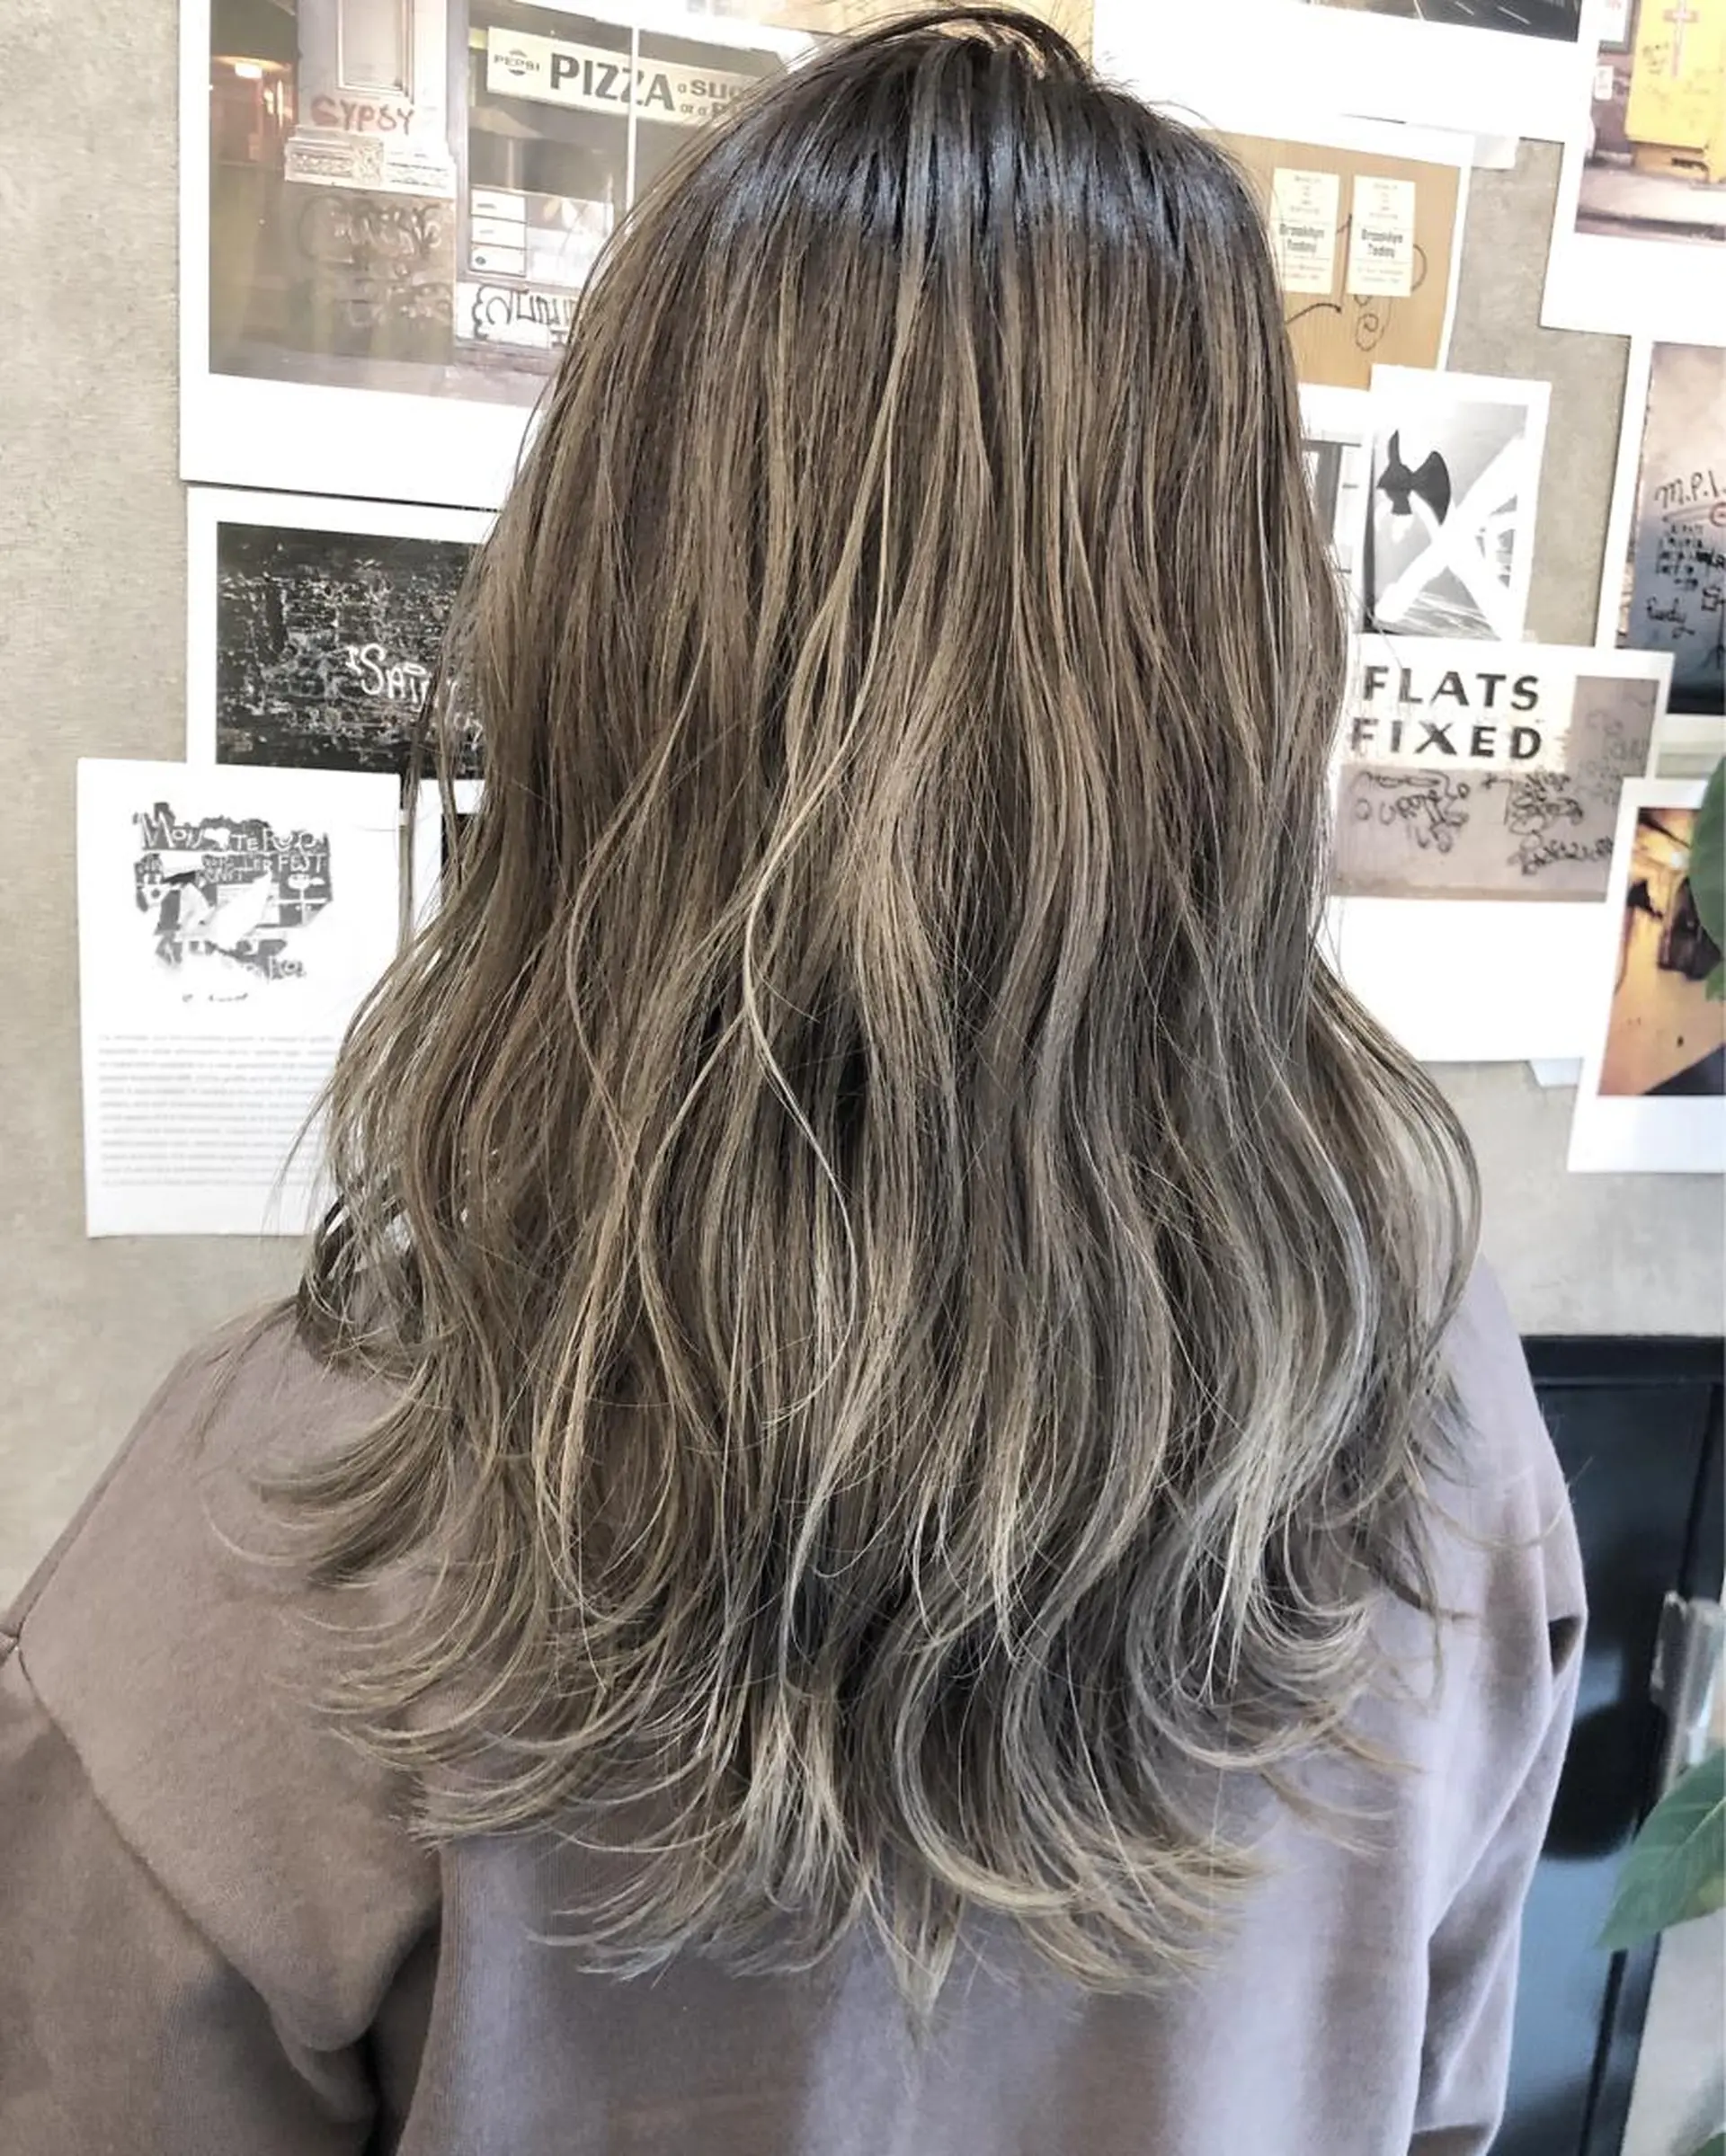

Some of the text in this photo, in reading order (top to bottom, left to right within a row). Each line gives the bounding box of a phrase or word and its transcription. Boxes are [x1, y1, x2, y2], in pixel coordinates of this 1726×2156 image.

[550, 52, 675, 111] PIZZA
[1362, 664, 1540, 712] FLATS
[1350, 716, 1543, 760] FIXED
